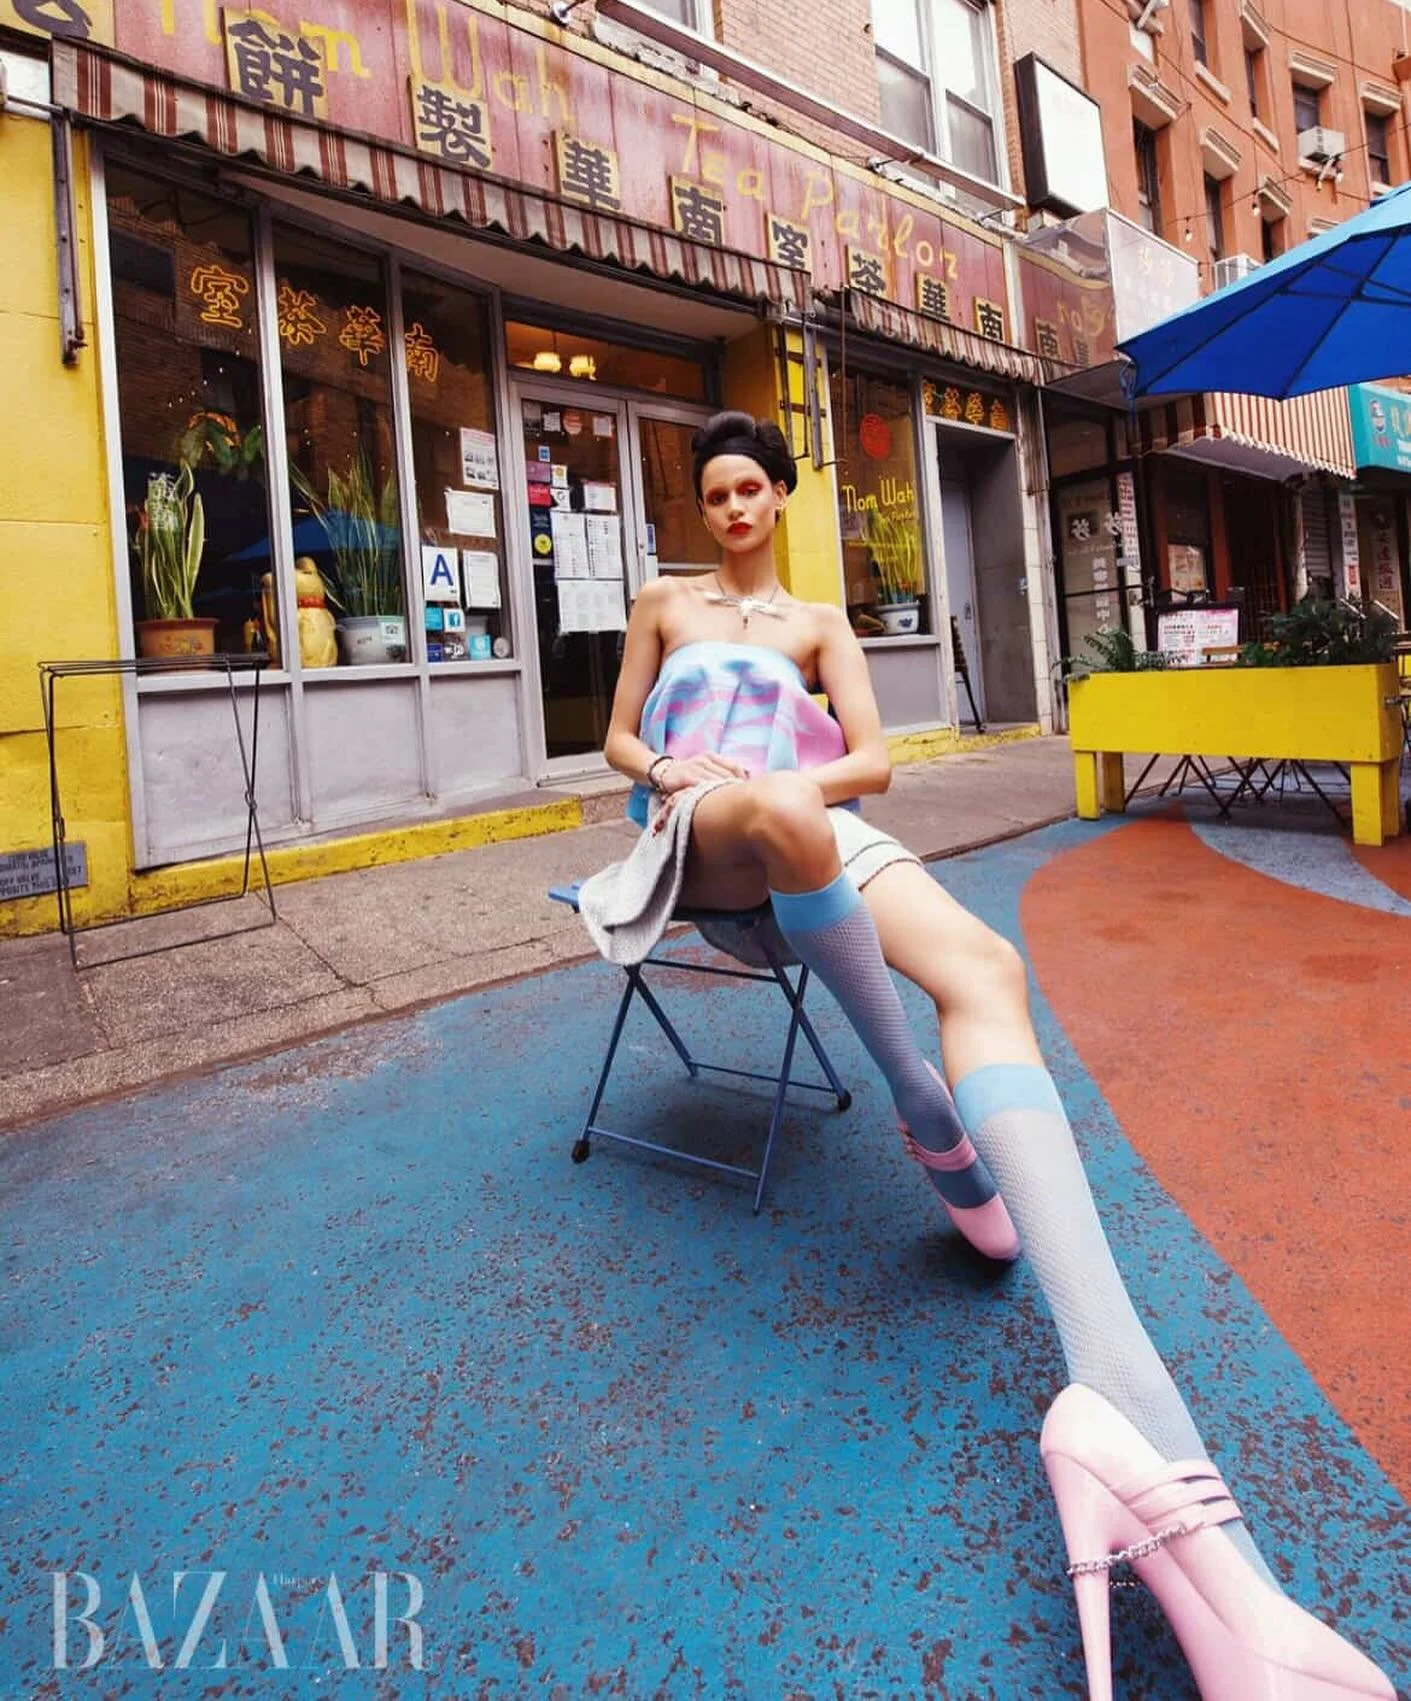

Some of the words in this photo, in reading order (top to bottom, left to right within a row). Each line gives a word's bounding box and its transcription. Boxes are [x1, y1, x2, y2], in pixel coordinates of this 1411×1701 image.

[407, 0, 577, 131] Wah
[672, 113, 765, 206] Tea
[801, 170, 958, 280] Parlor
[841, 485, 878, 513] Nom
[881, 477, 914, 506] Wah
[430, 554, 454, 586] A
